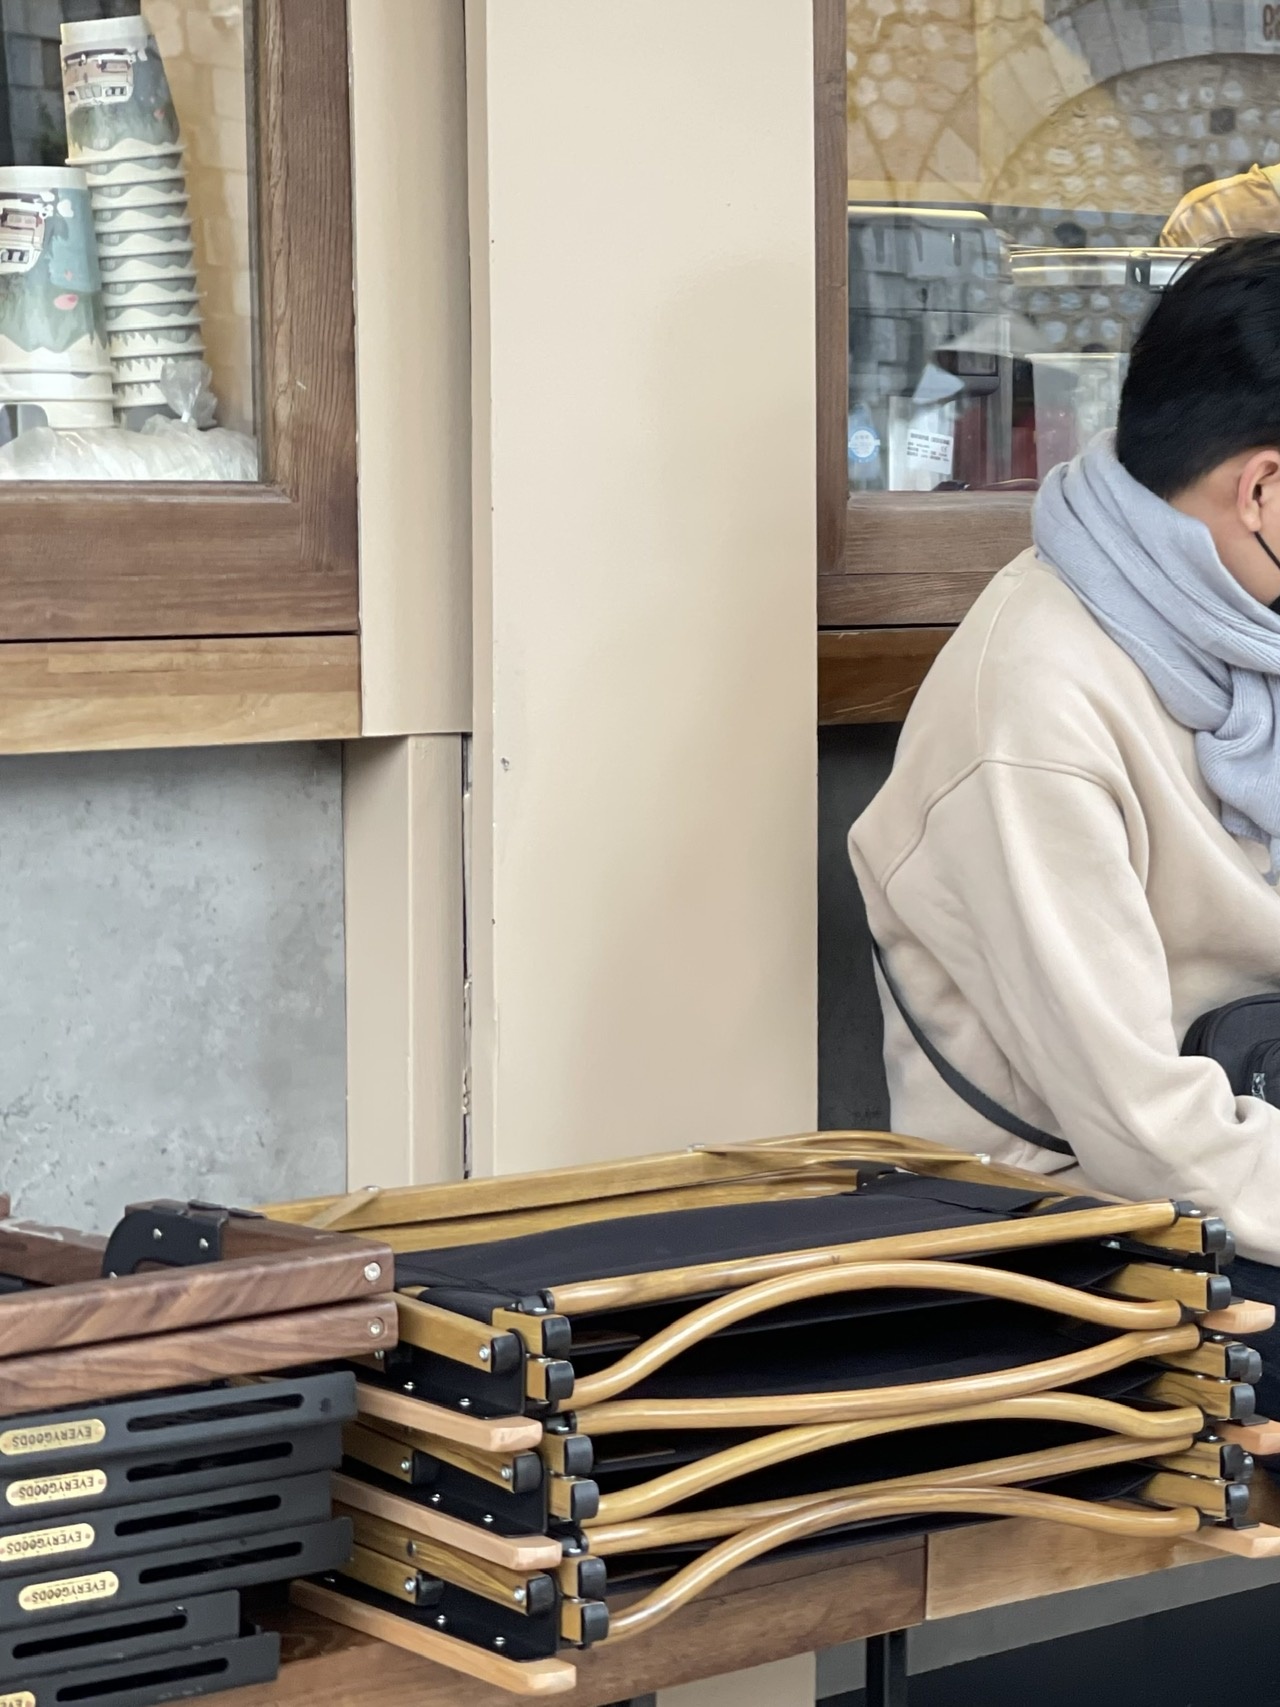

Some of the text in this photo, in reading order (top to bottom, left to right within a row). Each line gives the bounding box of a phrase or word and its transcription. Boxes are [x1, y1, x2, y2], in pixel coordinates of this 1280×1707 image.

[12, 1426, 92, 1446] EVERYGOODS
[18, 1476, 94, 1498] EVERYGOODS
[6, 1531, 82, 1554] EVERYGOODS
[31, 1579, 106, 1602] EVERYGOODS
